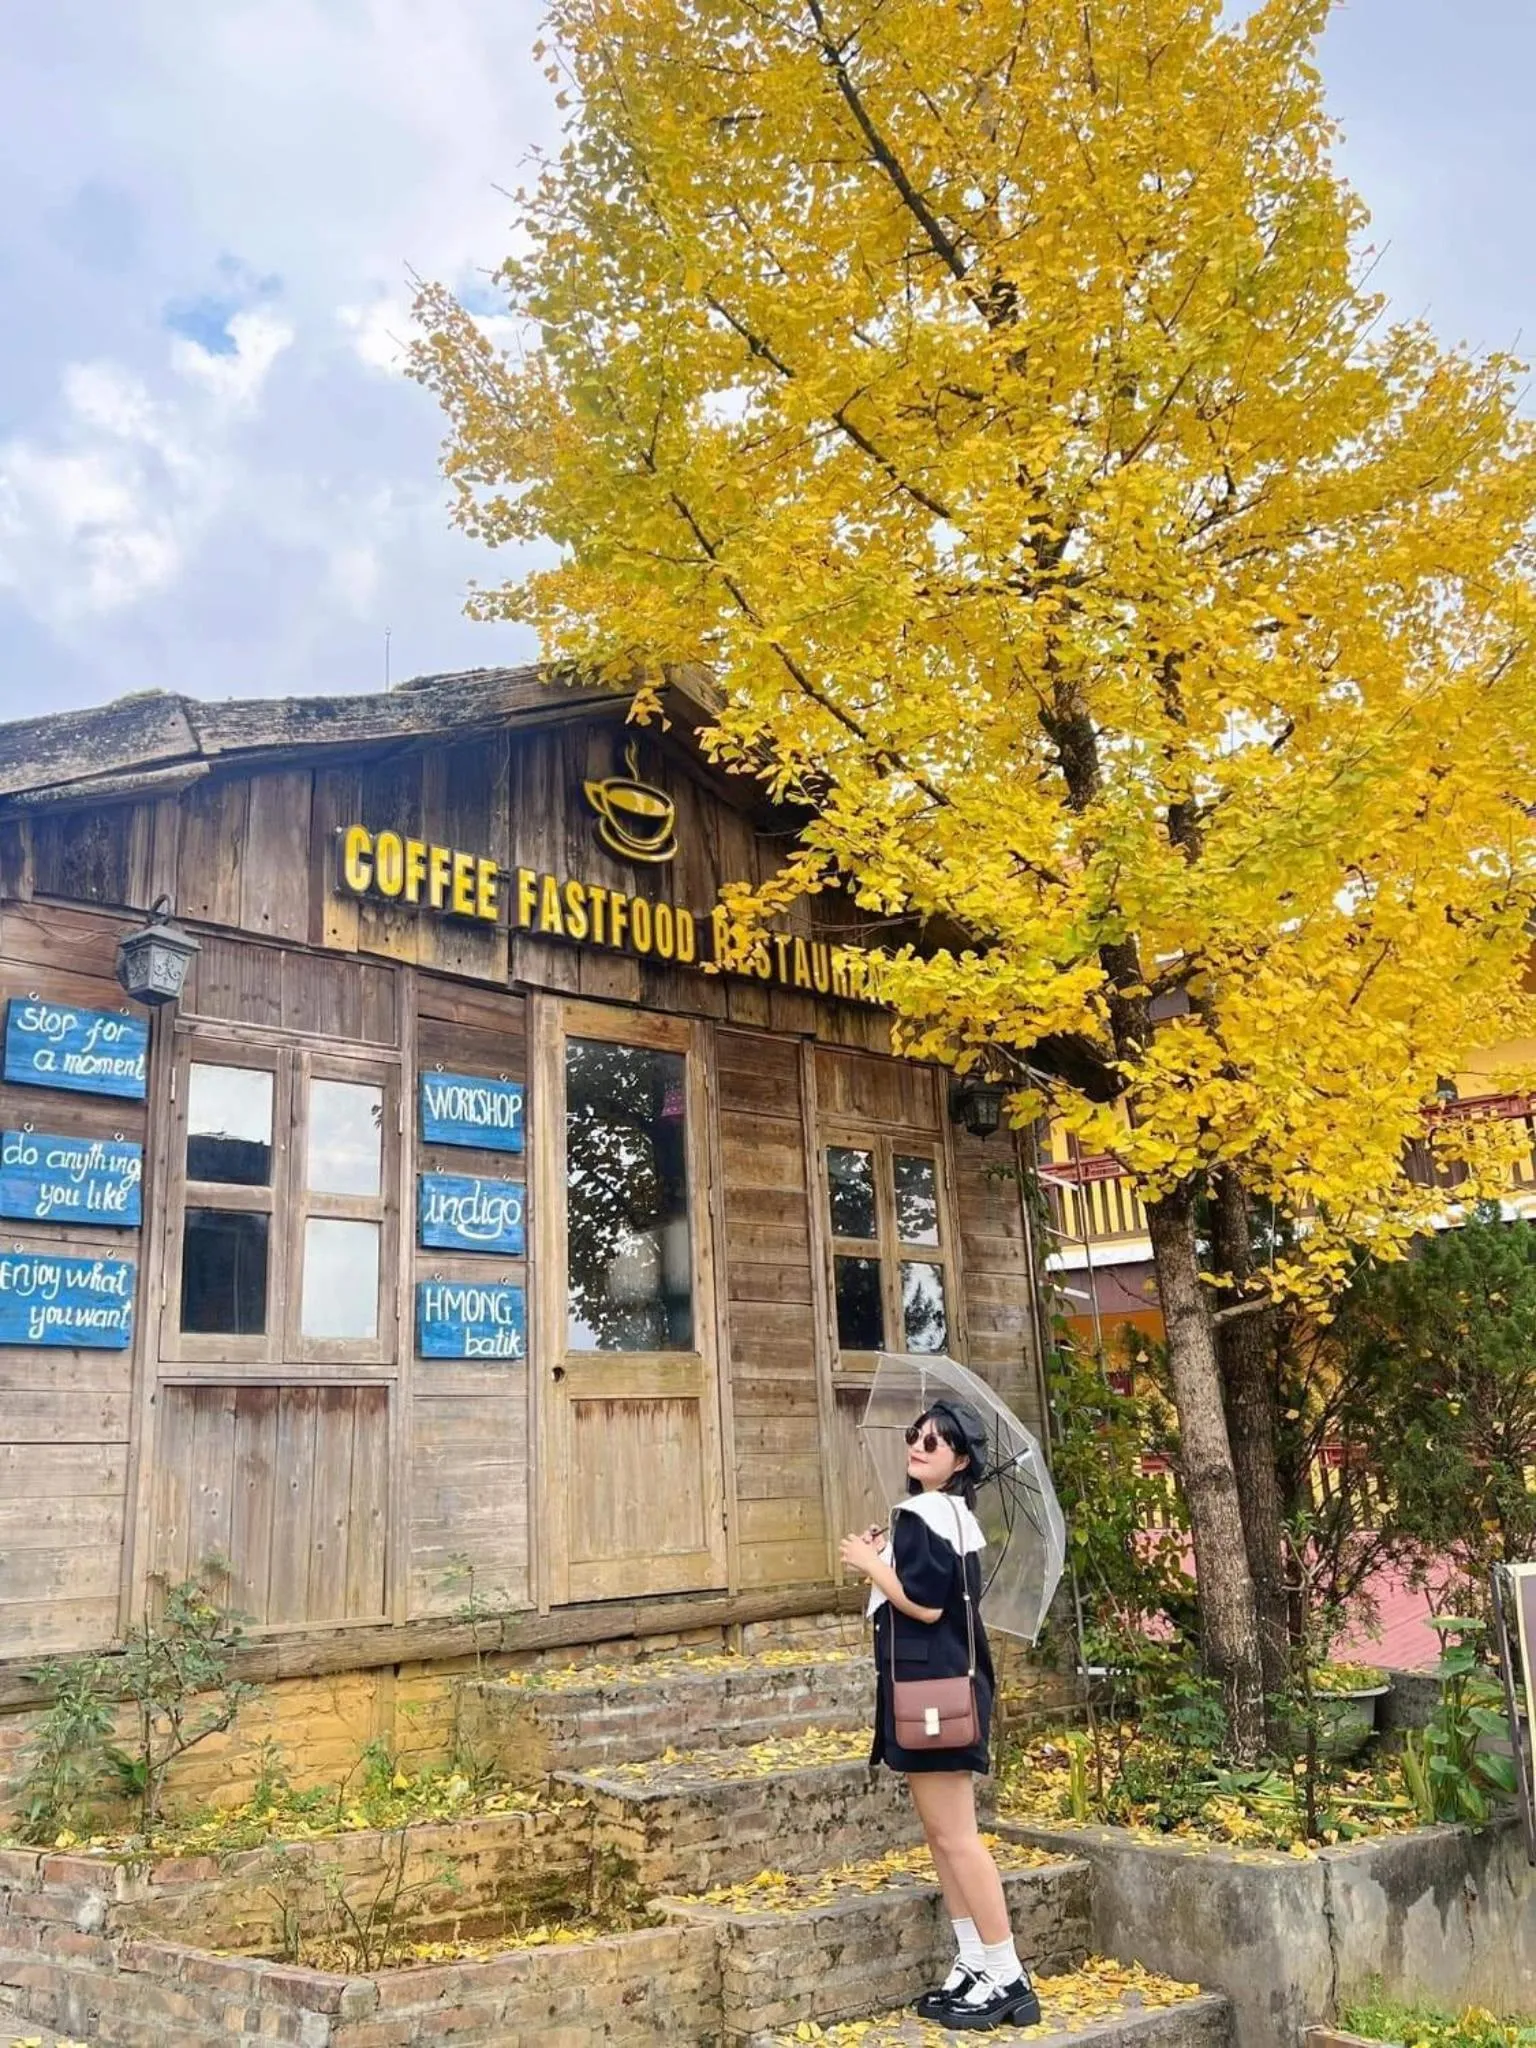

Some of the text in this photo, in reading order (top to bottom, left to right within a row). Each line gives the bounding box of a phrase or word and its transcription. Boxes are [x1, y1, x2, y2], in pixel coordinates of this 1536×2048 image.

[344, 825, 498, 922] COFFEE
[517, 866, 696, 963] FASTFOOD
[17, 1006, 133, 1052] Stop for
[32, 1049, 145, 1080] a moment
[425, 1084, 522, 1128] WORKSHOP
[3, 1132, 142, 1191] do anything
[35, 1179, 128, 1217] you like
[424, 1180, 521, 1239] indigo
[0, 1259, 128, 1300] Enjoy what
[28, 1300, 132, 1339] you want
[465, 1327, 525, 1357] batik
